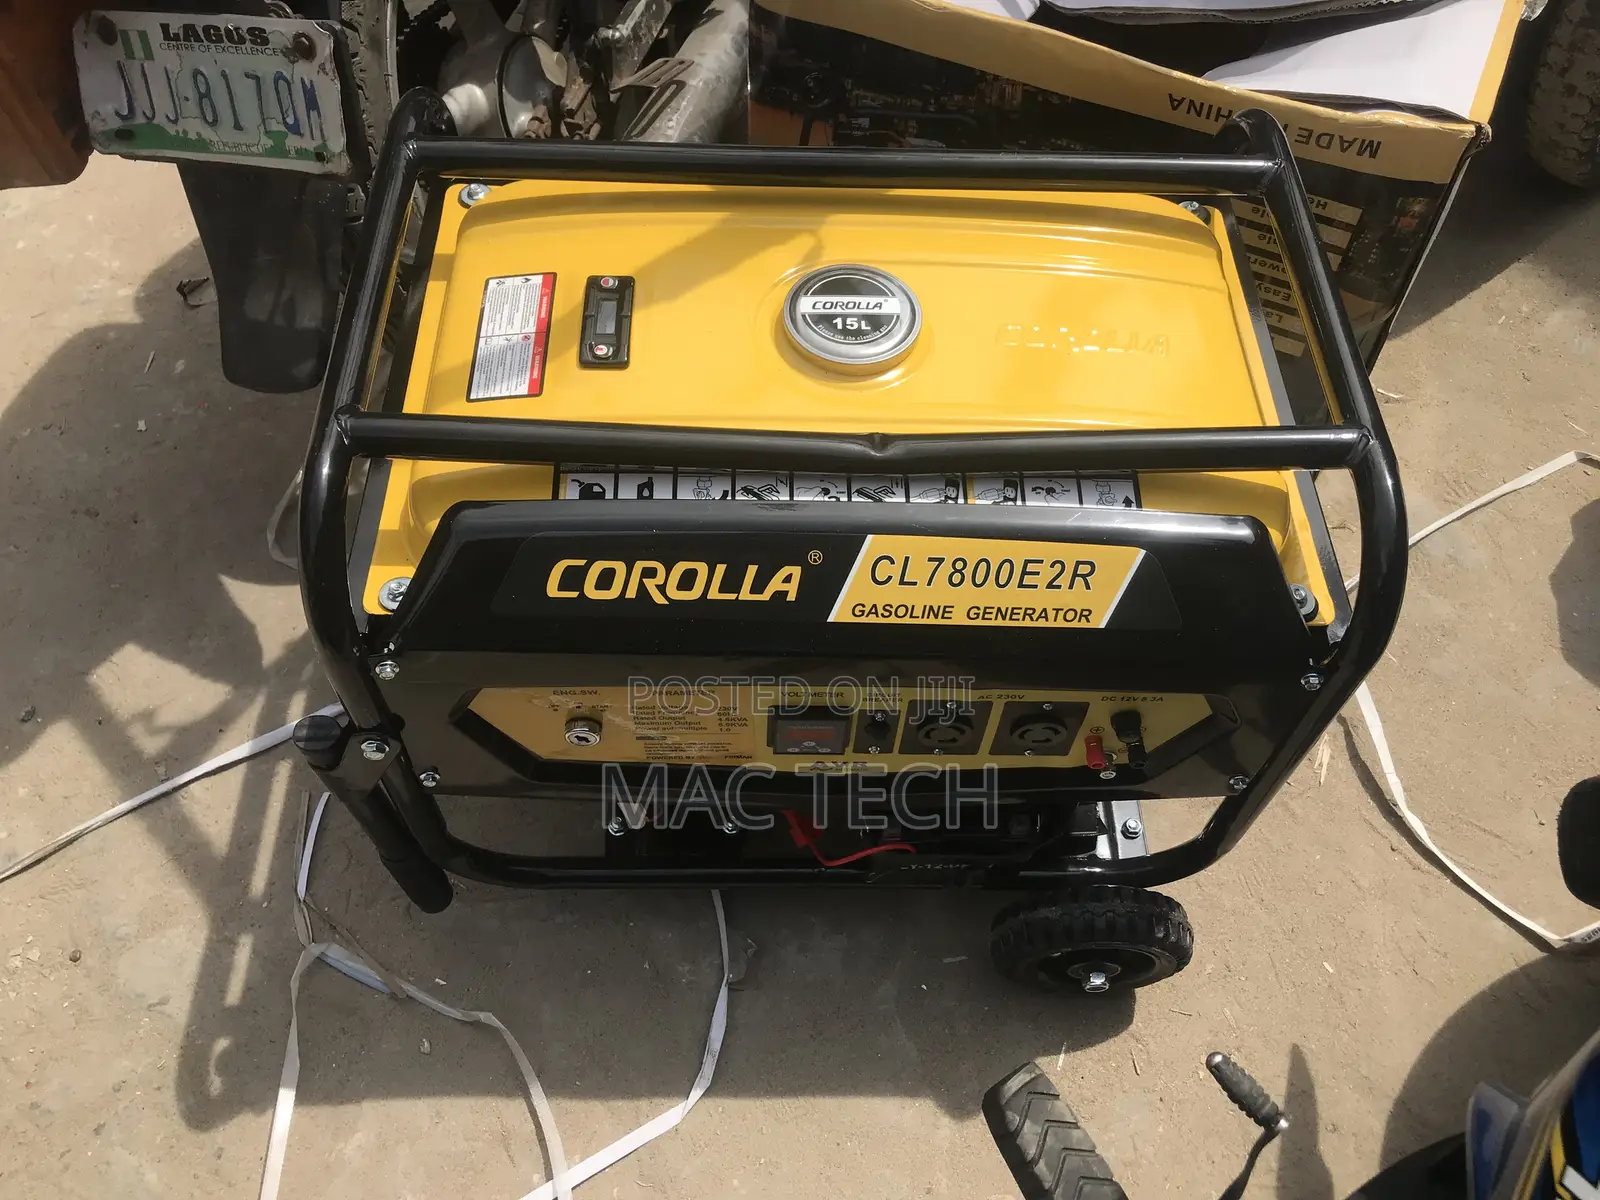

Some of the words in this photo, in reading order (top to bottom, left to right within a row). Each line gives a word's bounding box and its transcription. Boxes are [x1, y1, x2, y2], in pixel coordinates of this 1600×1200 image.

[159, 22, 271, 47] LAGOS
[159, 42, 196, 52] CENTRE
[199, 44, 213, 53] OF
[214, 44, 281, 57] EXCELLENCE
[1168, 92, 1234, 123] HINA
[1294, 127, 1383, 160] MADE
[812, 300, 883, 310] COROLLA
[832, 317, 871, 330] 15L
[546, 559, 801, 604] COROLLA
[870, 554, 1097, 591] CL7800E2R
[851, 602, 954, 620] GASOLINE
[966, 605, 1093, 623] GENERATOR
